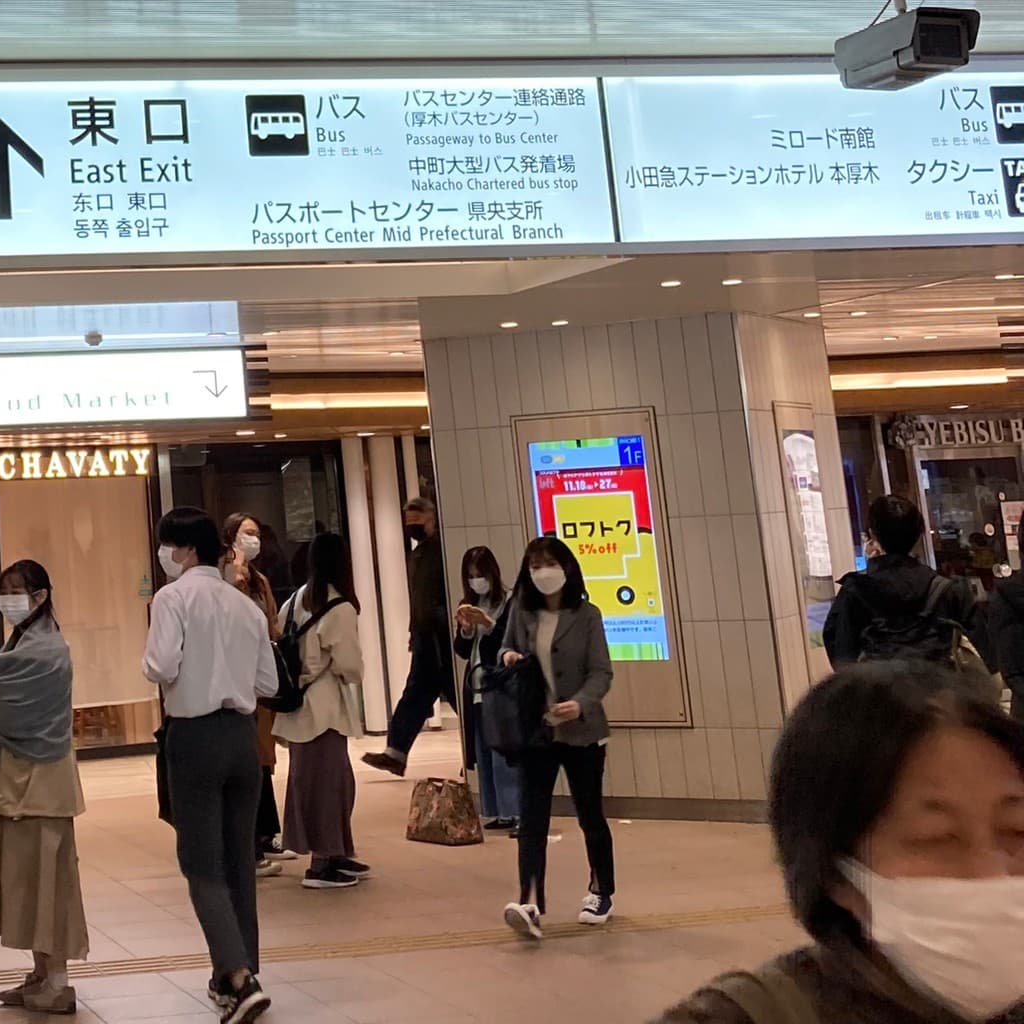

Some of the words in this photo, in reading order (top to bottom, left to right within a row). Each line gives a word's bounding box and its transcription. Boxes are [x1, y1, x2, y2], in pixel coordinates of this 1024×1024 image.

[316, 94, 365, 119] バス
[403, 88, 586, 107] バスセンター連絡通路
[940, 87, 984, 111] バス
[67, 96, 190, 147] 東口
[961, 118, 988, 132] Bus
[316, 127, 346, 142] Bus
[406, 133, 474, 147] Passageway
[479, 133, 492, 144] to
[495, 132, 516, 144] Bus
[520, 131, 558, 144] Center
[770, 127, 875, 150] ミロード南館
[70, 157, 127, 184] East
[140, 155, 192, 182] Exit
[409, 154, 576, 175] 中町大型バス発着場
[907, 159, 994, 184] タクシー
[411, 178, 463, 191] Nakacho
[467, 177, 525, 191] Chartered
[529, 177, 550, 190] bus
[553, 178, 578, 191] stop
[72, 192, 113, 212] 东口
[127, 192, 167, 211] 東口
[968, 189, 999, 205] Taxi
[252, 199, 458, 224] パスポートセンター
[467, 200, 543, 221] 県央支所
[73, 218, 109, 238] 동쪽
[116, 217, 169, 238] 출입구
[252, 229, 318, 247] Passport
[325, 228, 375, 244] Center
[383, 226, 411, 242] Mid
[420, 224, 504, 241] Prefectural
[513, 223, 563, 239] Branch
[63, 390, 173, 410] Market
[921, 419, 1005, 447] YEBISU
[562, 520, 631, 539] ロフトク
